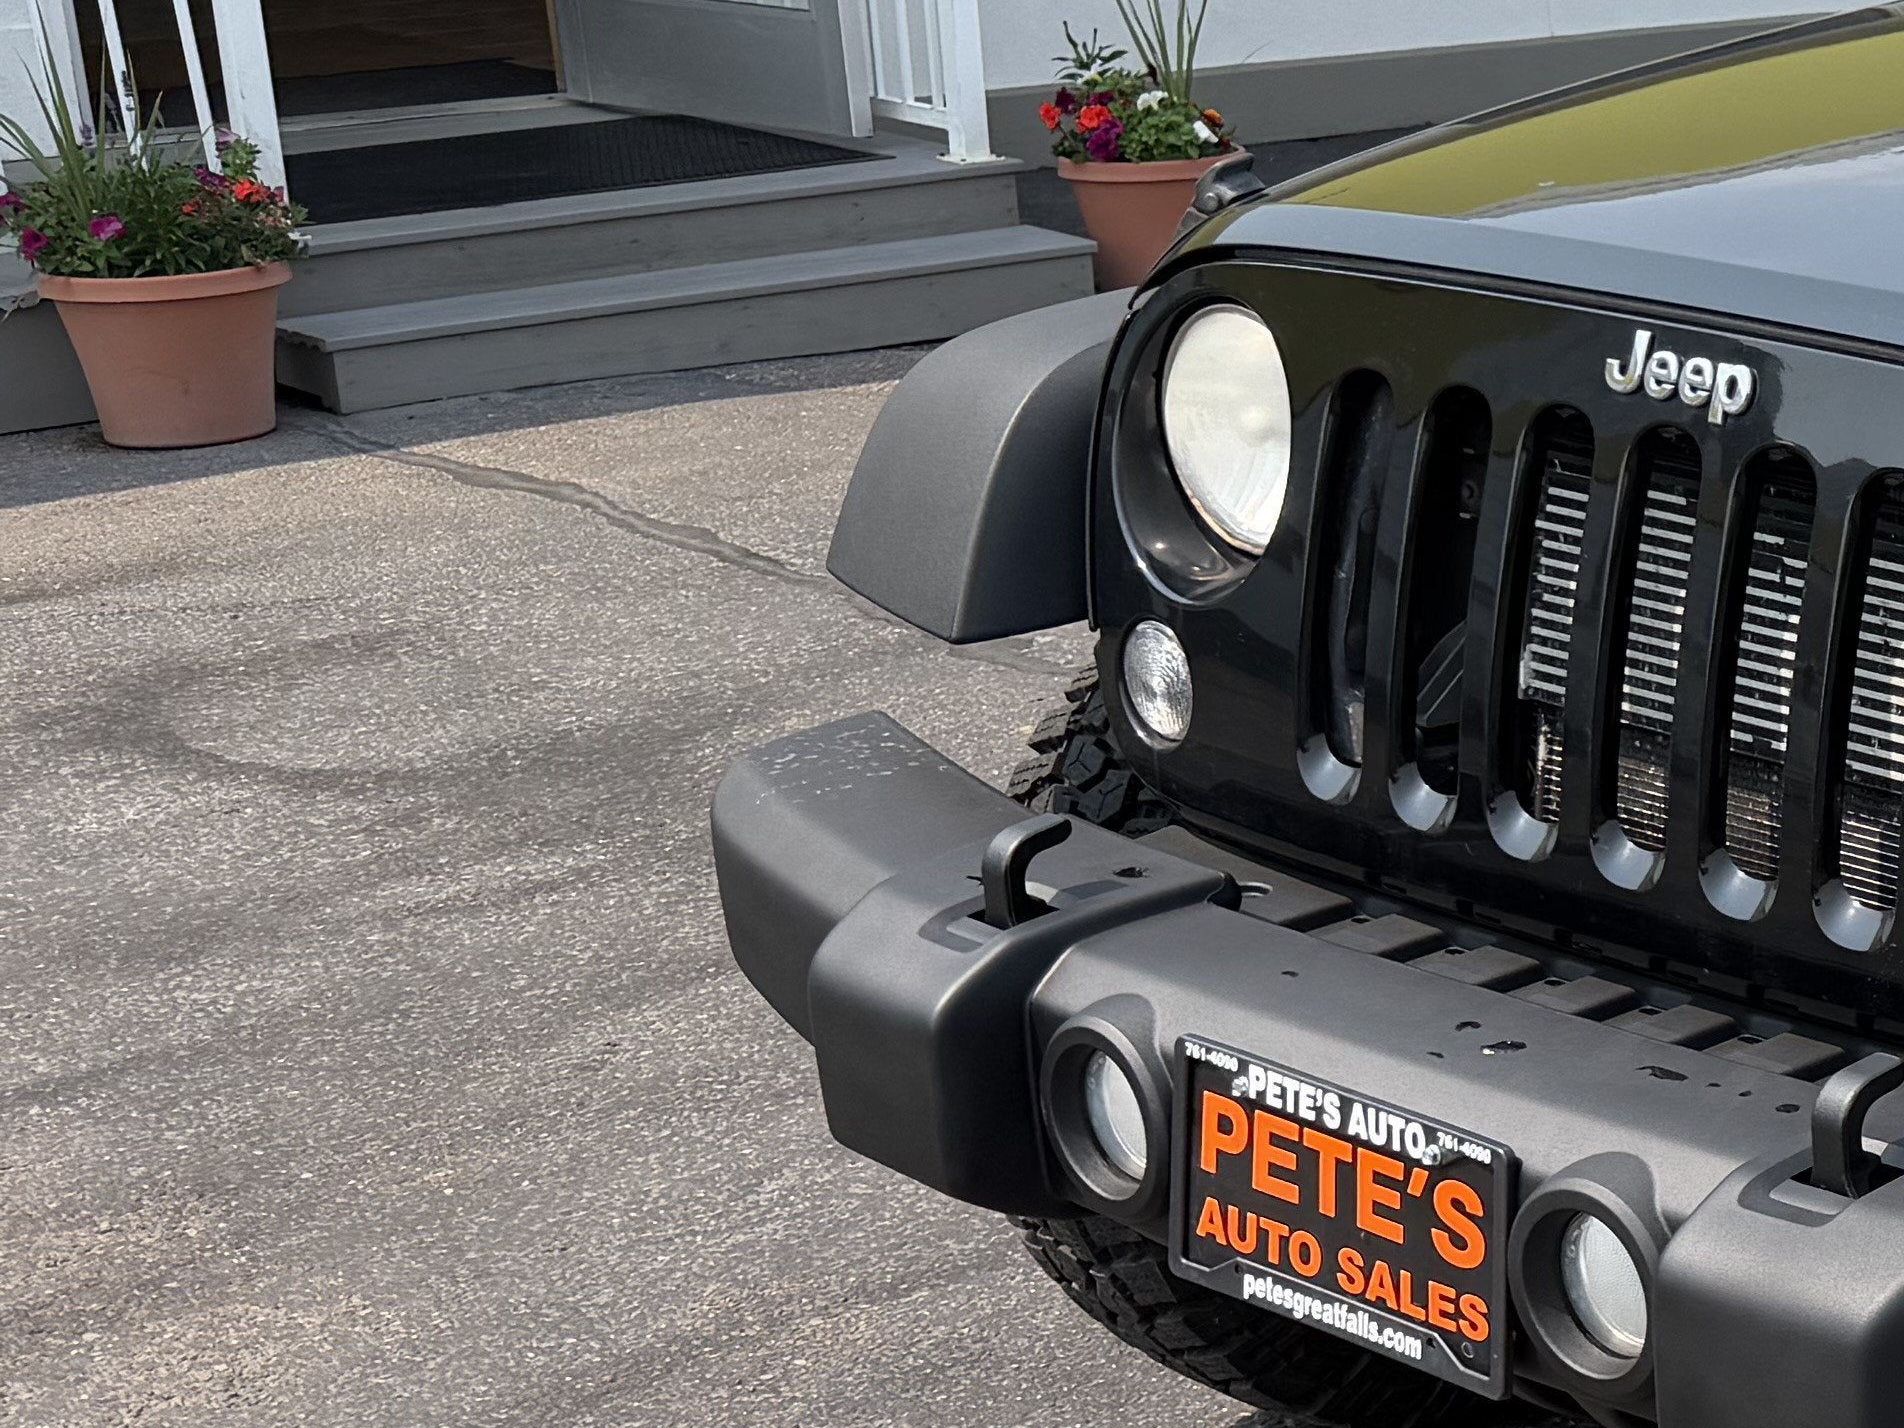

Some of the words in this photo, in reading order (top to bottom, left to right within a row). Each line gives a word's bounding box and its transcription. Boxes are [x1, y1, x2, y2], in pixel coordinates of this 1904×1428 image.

[1605, 329, 1757, 426] Jeep
[1249, 1065, 1341, 1130] PETE'S
[1348, 1102, 1426, 1160] AUTO
[1200, 1090, 1486, 1269] PETE'S
[1196, 1197, 1323, 1277] AUTO
[1337, 1247, 1490, 1342] SALES
[1243, 1274, 1423, 1360] petesgreatfalls.com
